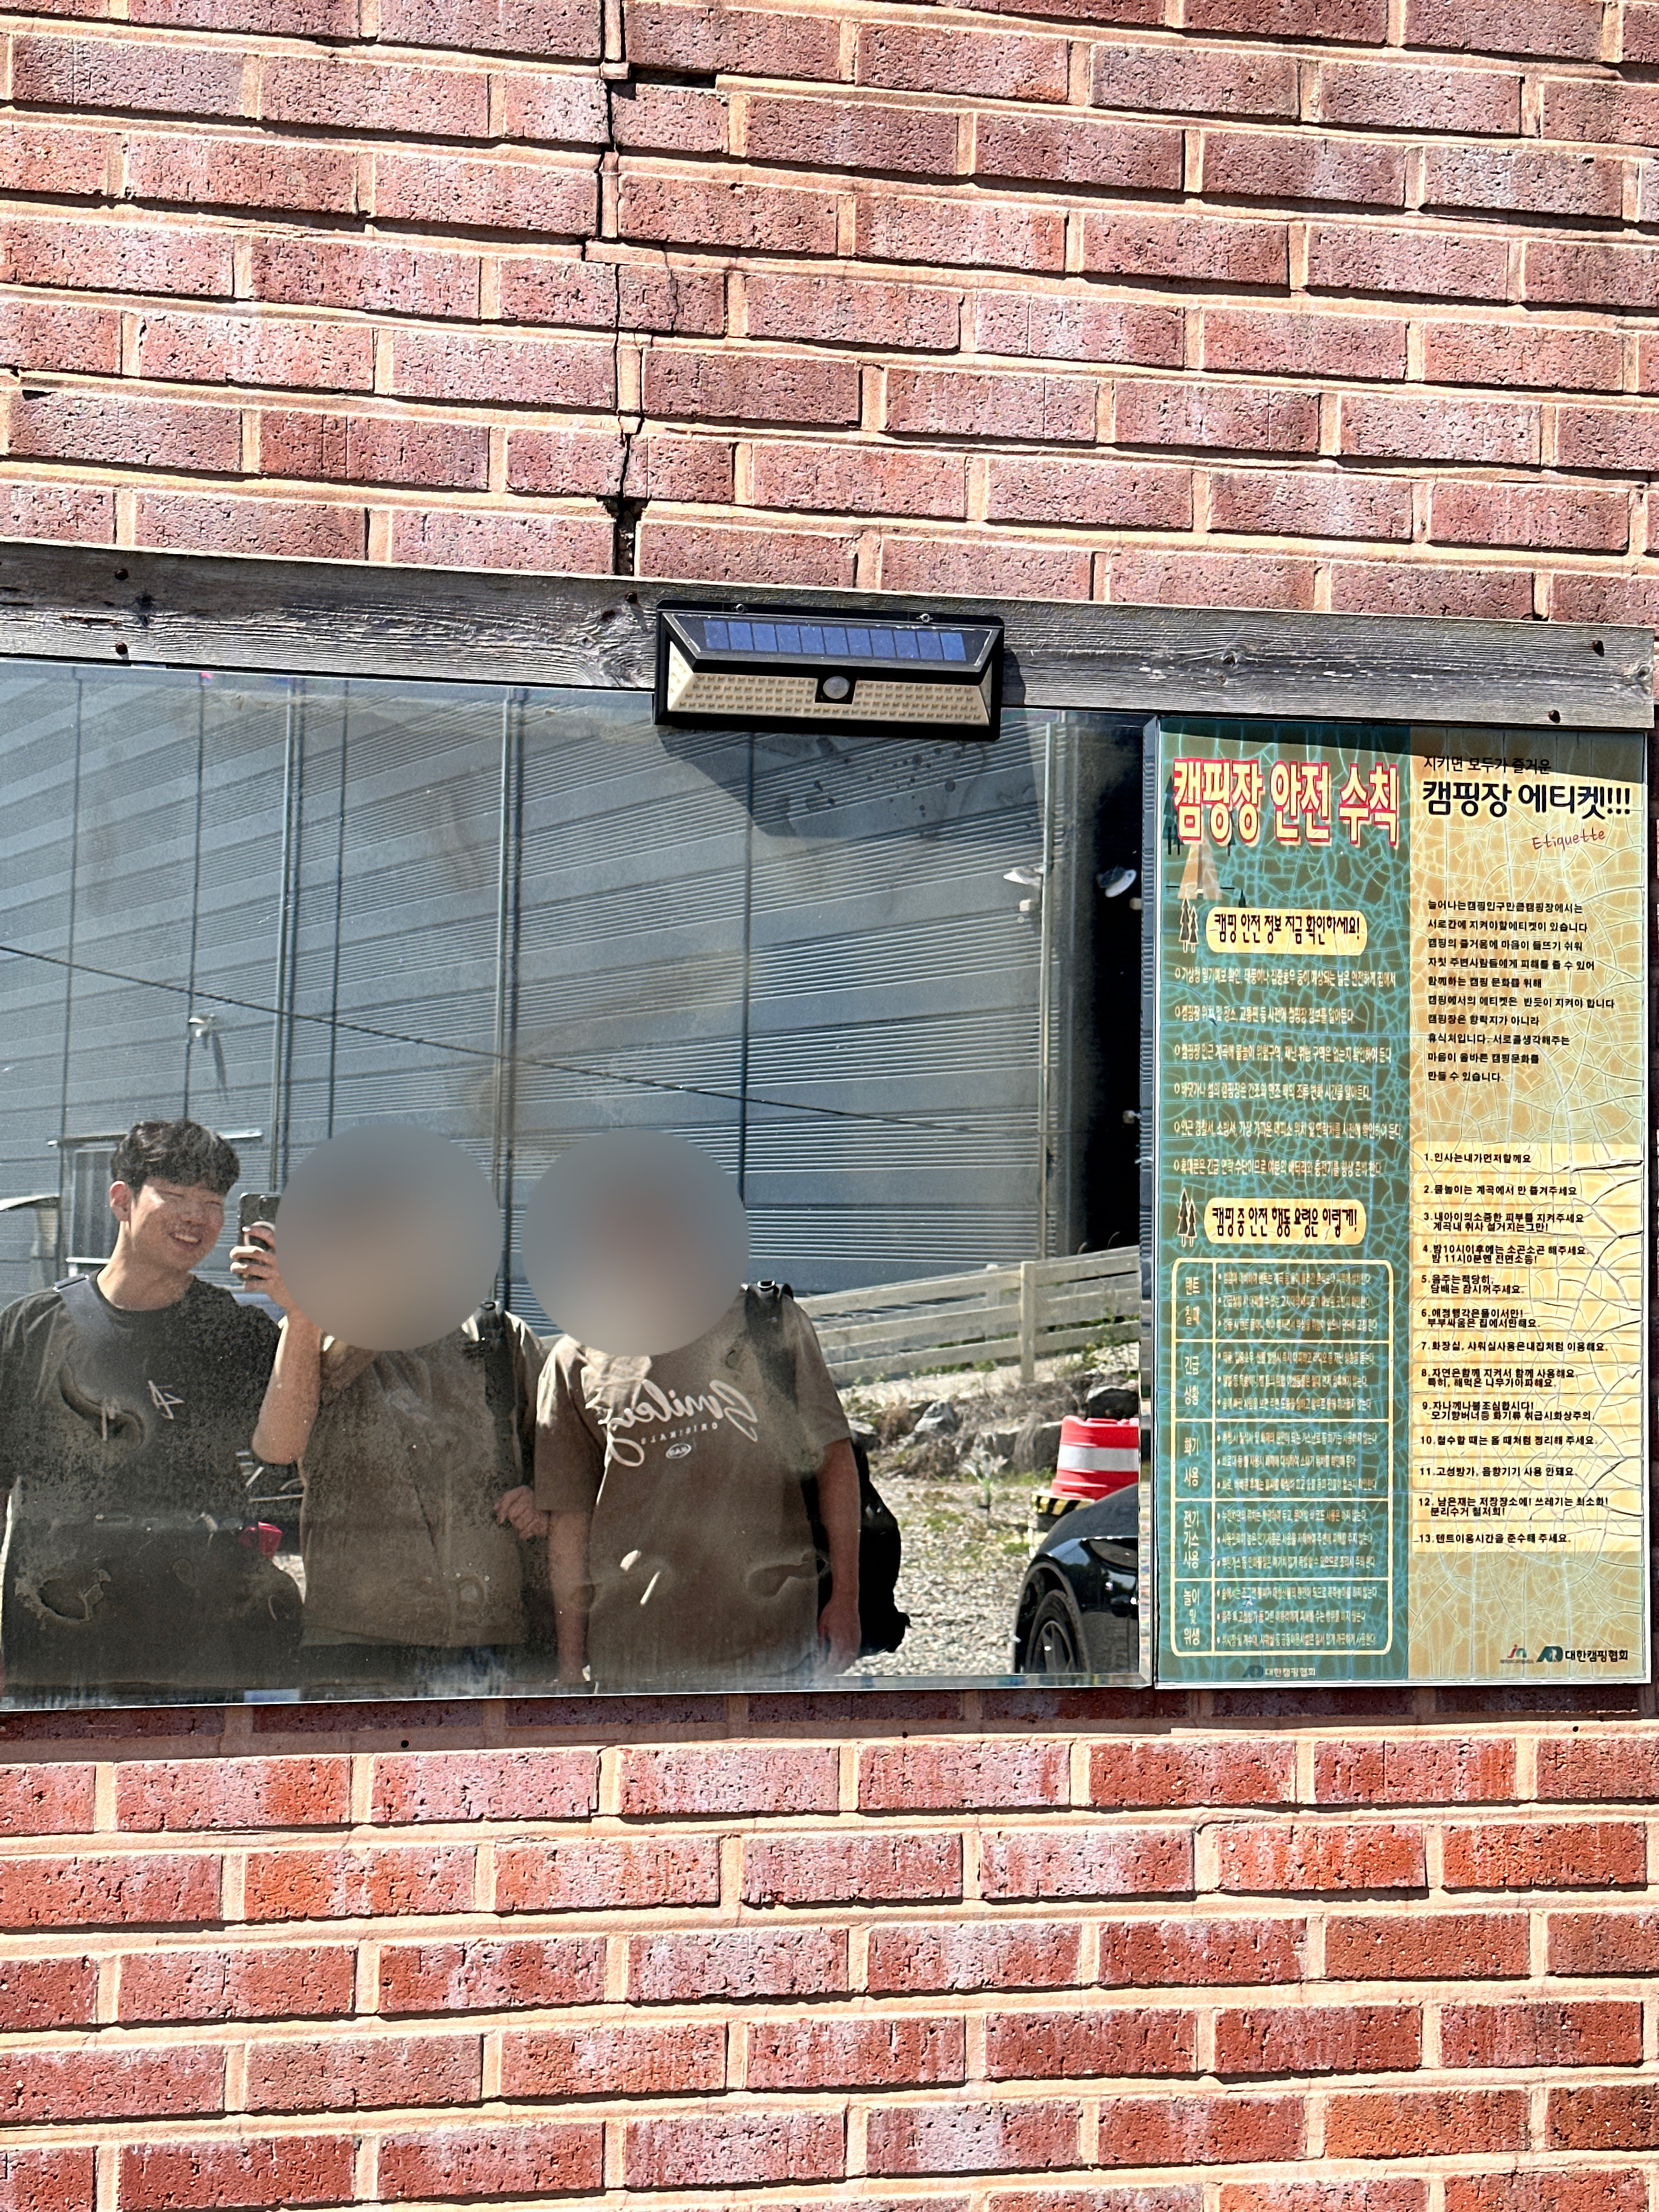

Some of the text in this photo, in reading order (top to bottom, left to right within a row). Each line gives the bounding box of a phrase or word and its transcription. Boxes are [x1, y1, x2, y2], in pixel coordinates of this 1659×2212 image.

[1424, 755, 1551, 775] 지키면 모두가 즐거운
[1173, 757, 1400, 849] 캠핑장 안전 수칙
[1423, 781, 1630, 820] 캠핑장 에티켓!!!
[1531, 828, 1606, 851] Etiquette
[1214, 913, 1359, 945] 캠핑 안전 정보 지금 확인하세요!
[1428, 919, 1466, 930] 서로간에
[1549, 922, 1588, 933] 있습니다
[1428, 938, 1583, 951] 캠핑의 즐거움에 마음이 들뜨기 쉬워
[1428, 957, 1447, 967] 자칫
[1449, 957, 1517, 969] 주변사람들에게
[1521, 960, 1549, 969] 피해를
[1564, 961, 1573, 970] 수
[1576, 961, 1594, 970] 있어
[1428, 976, 1542, 988] 함께하는 캠핑 문화를 위해
[1428, 995, 1615, 1008] 캠핑에서의 에티켓은 반듯이 지켜야 합니다
[1428, 1014, 1539, 1026] 캠핑장은 향락지가 아니라
[1428, 1052, 1457, 1062] 마음이
[1460, 1053, 1488, 1063] 올바른
[1428, 1071, 1504, 1082] 만들 수 있습니다.
[1476, 1186, 1514, 1196] 계곡에서
[1517, 1186, 1526, 1196] 만
[1212, 1207, 1357, 1238] 캠핑 중 안전 행동 요령은 이렇게!
[1505, 1213, 1533, 1223] 피부를
[1537, 1214, 1584, 1223] 지켜주세요
[1433, 1222, 1462, 1232] 계곡내
[1507, 1245, 1545, 1256] 소곤소곤
[1432, 1254, 1441, 1264] 밤
[1185, 1277, 1200, 1295] 텐트
[1431, 1284, 1460, 1295] 담배는
[1427, 1318, 1476, 1328] 부부싸움은
[1184, 1356, 1199, 1375] 긴급
[1483, 1369, 1512, 1379] 지켜서
[1515, 1369, 1534, 1379] 함께
[1454, 1378, 1483, 1388] 해먹은
[1184, 1385, 1199, 1406] 상황
[1493, 1411, 1521, 1421] 화기류
[1184, 1437, 1199, 1456] 화기
[1469, 1435, 1488, 1446] 때는
[1491, 1435, 1500, 1446] 올
[1503, 1435, 1531, 1446] 때처럼
[1534, 1435, 1563, 1446] 정리해
[1184, 1466, 1199, 1487] 사용
[1482, 1466, 1520, 1477] 음향기기
[1523, 1466, 1542, 1477] 사용
[1437, 1497, 1476, 1507] 남은재는
[1534, 1497, 1573, 1507] 쓰레기는
[1183, 1509, 1199, 1528] 전기
[1431, 1507, 1469, 1517] 분리수거
[1183, 1531, 1199, 1548] 가스
[1183, 1550, 1199, 1570] 사용
[1183, 1588, 1200, 1607] 놀이
[1183, 1628, 1200, 1646] 위생
[1565, 1649, 1628, 1662] 대한캠핑협회
